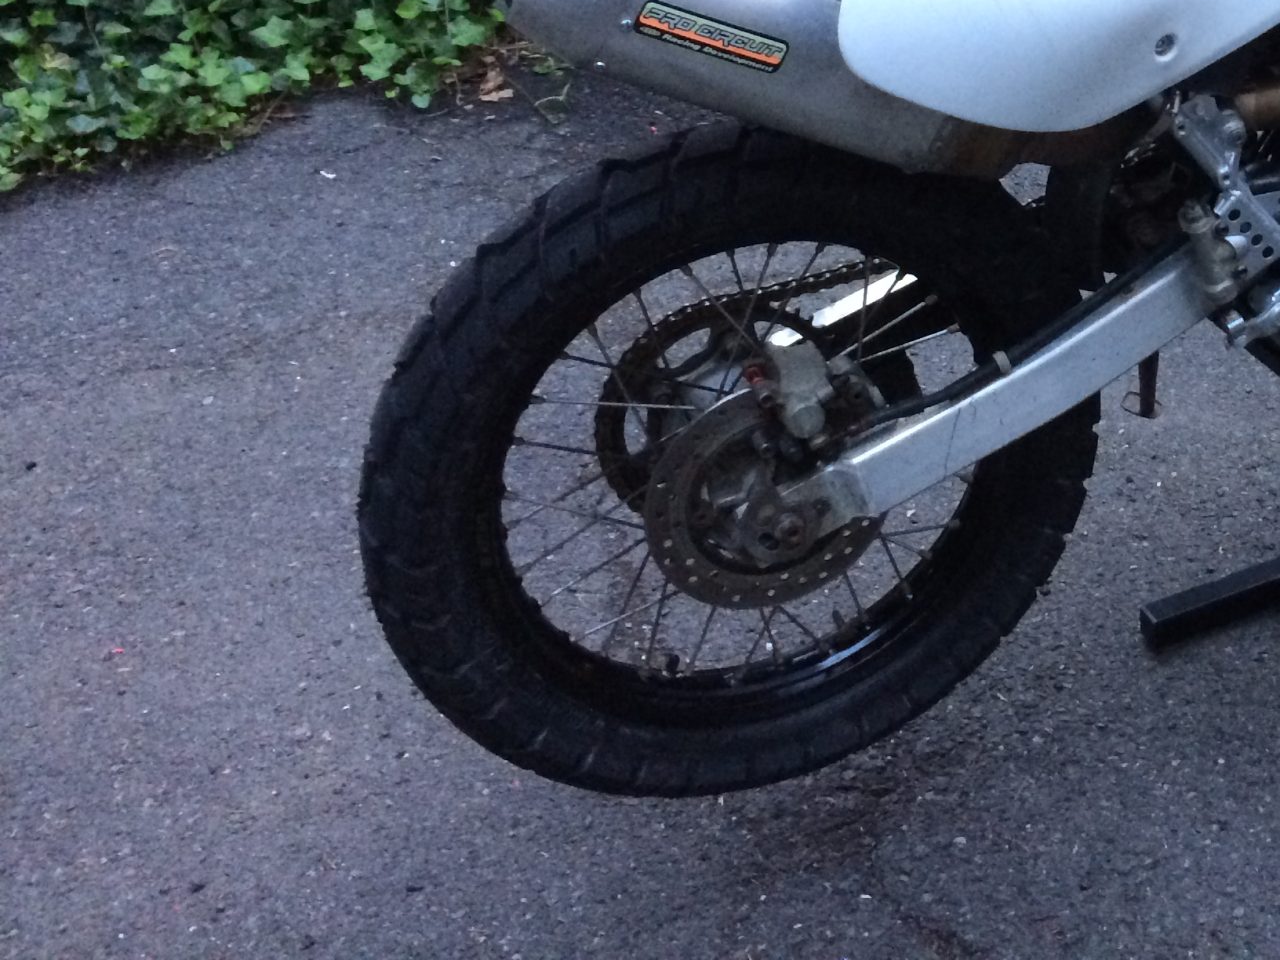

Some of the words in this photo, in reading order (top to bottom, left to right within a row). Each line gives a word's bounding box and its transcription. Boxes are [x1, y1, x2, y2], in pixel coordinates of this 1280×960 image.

[643, 6, 697, 32] PRO
[695, 23, 783, 58] CIRCUIT
[661, 33, 701, 52] Racing
[702, 45, 774, 72] Development
